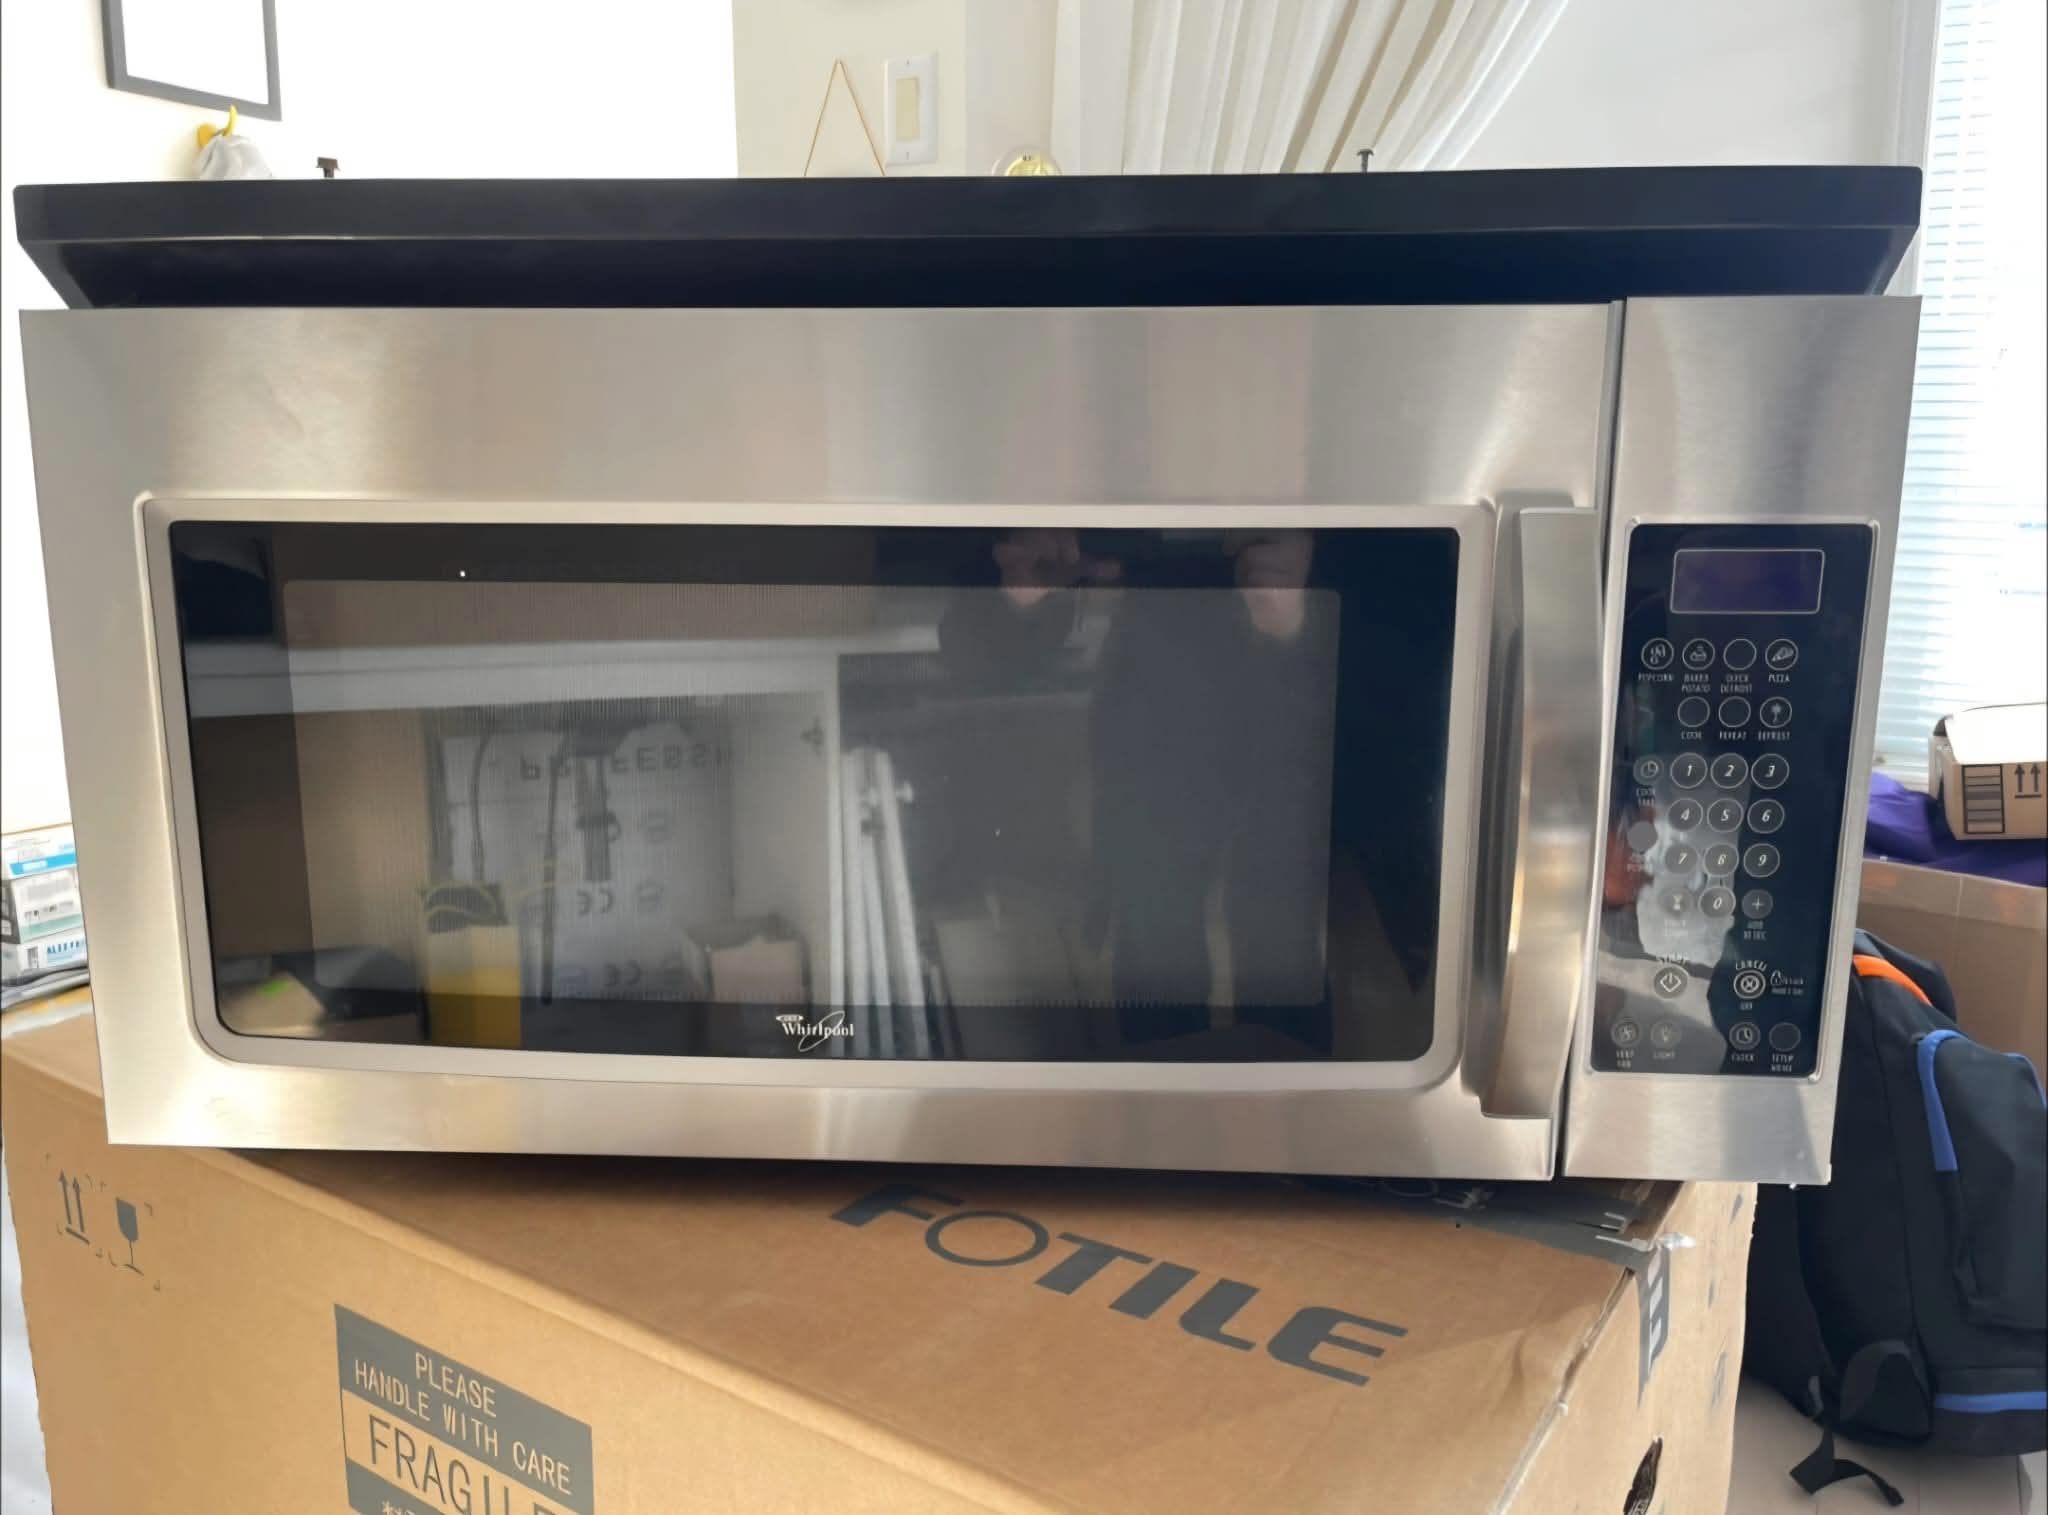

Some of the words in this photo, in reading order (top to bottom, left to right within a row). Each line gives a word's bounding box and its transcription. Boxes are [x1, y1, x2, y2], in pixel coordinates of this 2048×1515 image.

[1686, 765, 1693, 777] 1
[1724, 765, 1734, 777] 2
[1765, 766, 1775, 777] 3
[1680, 809, 1690, 821] 4
[1721, 810, 1730, 821] 5
[1762, 809, 1771, 821] 6
[1678, 854, 1687, 865] 7
[1718, 854, 1727, 865] 8
[1758, 854, 1768, 866] 9
[1713, 898, 1722, 909] 0
[782, 1021, 855, 1040] Whirlpool
[830, 1182, 1409, 1387] FOTILE
[415, 1351, 497, 1418] PLEASE
[355, 1359, 431, 1422] HANDLE
[442, 1403, 499, 1457] WITH
[512, 1441, 573, 1496] CARE
[368, 1413, 556, 1515] FRAGI
